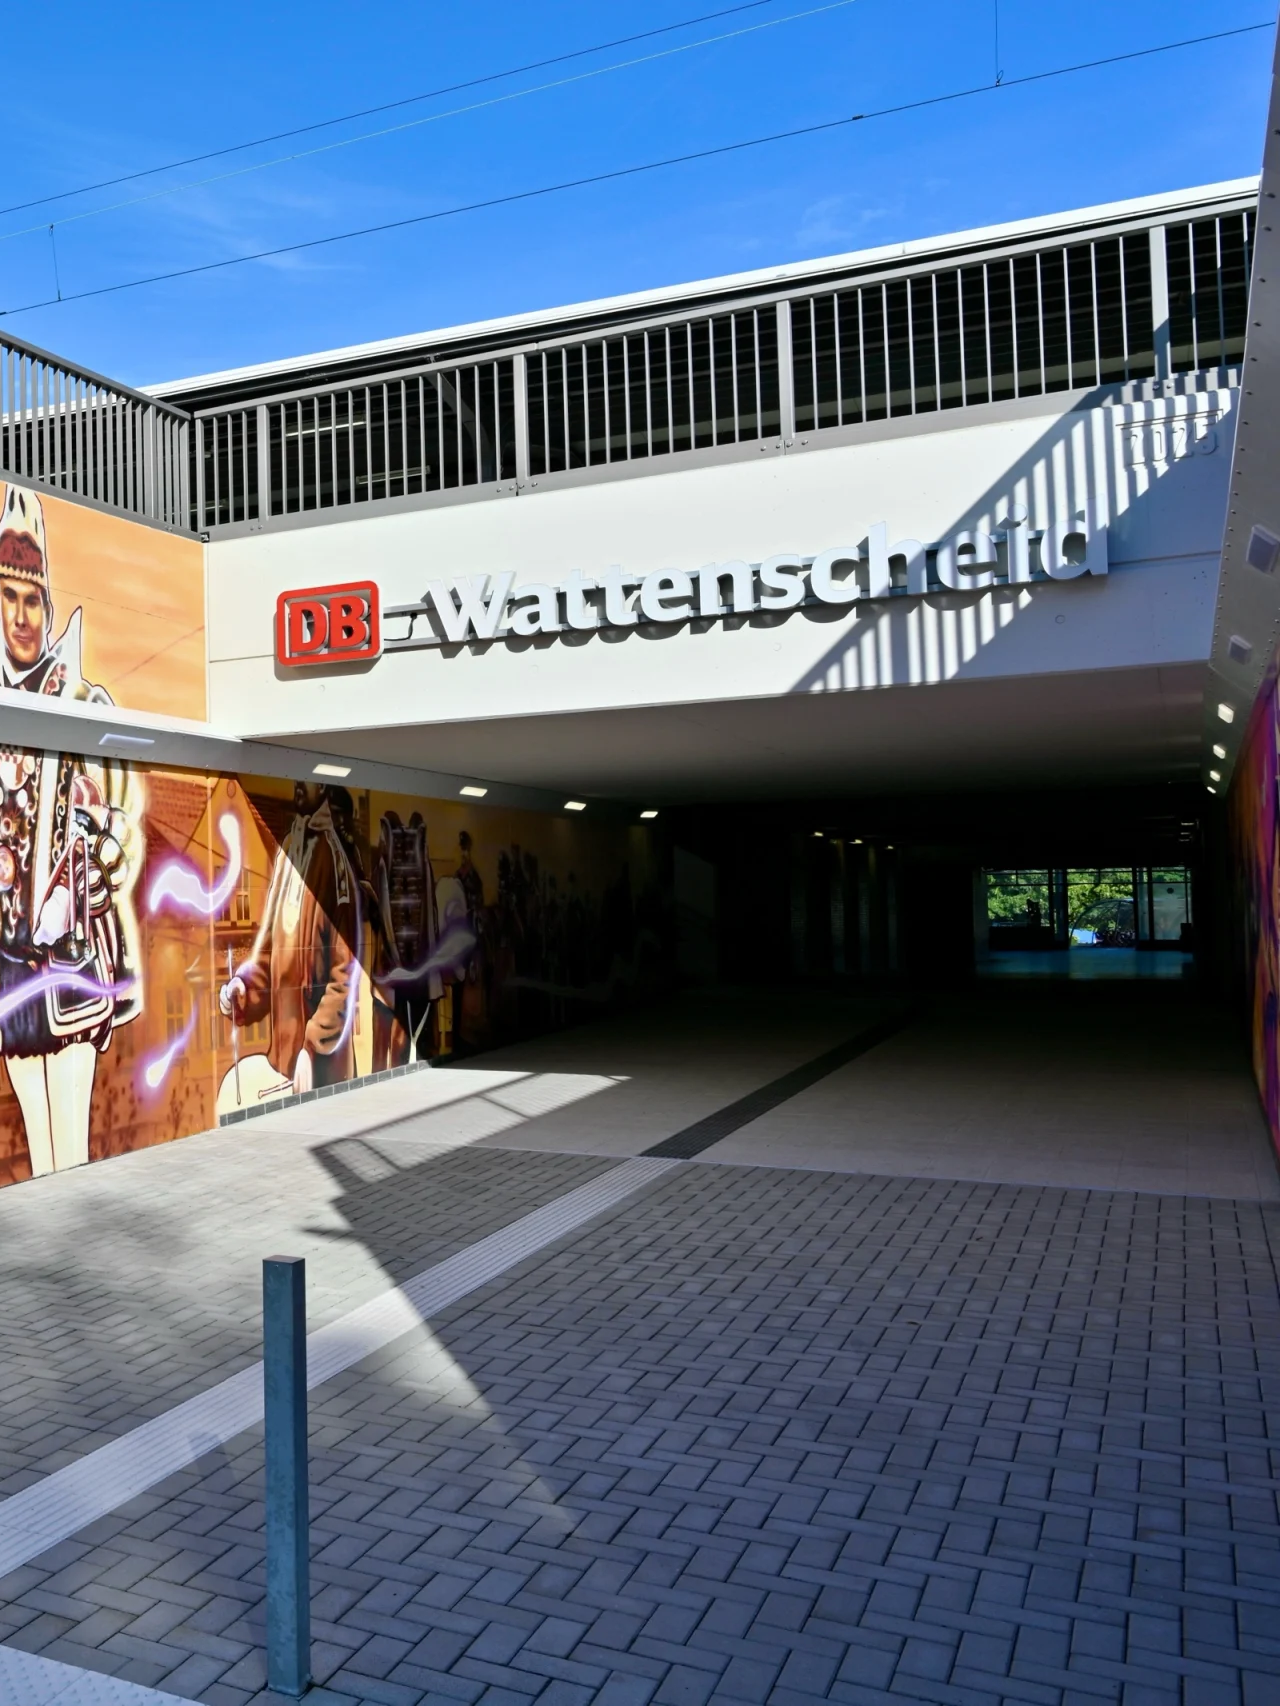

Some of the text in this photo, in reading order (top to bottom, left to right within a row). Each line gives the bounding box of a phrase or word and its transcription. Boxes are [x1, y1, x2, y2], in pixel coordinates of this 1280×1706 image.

[1124, 420, 1219, 466] 2025
[289, 497, 1109, 653] DB Wattenscheid
